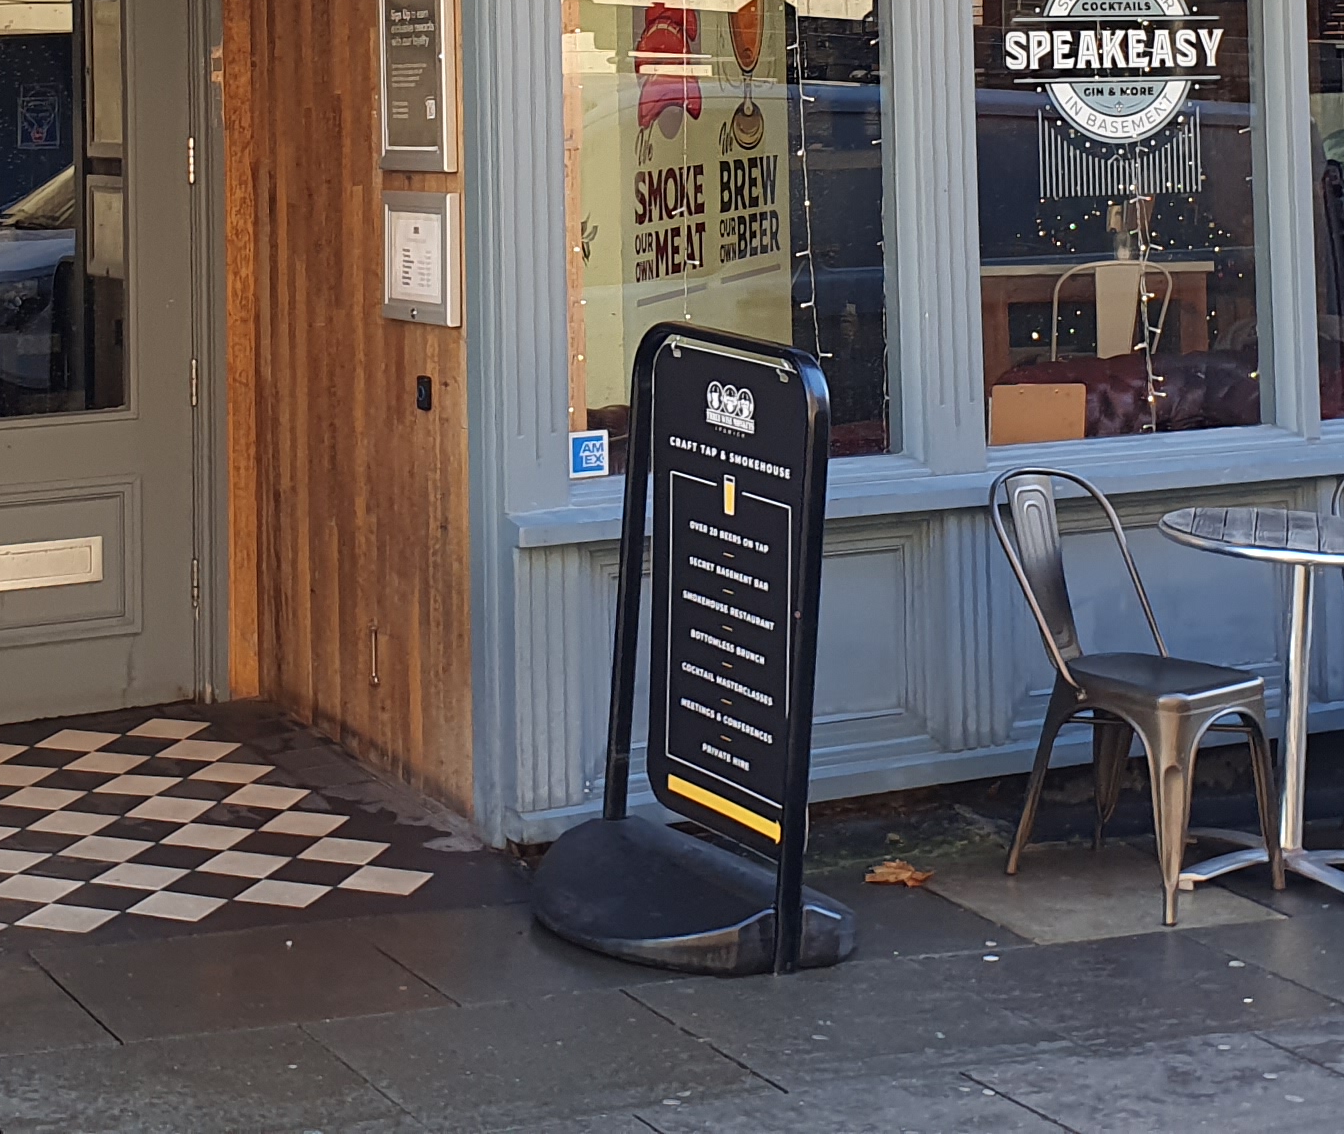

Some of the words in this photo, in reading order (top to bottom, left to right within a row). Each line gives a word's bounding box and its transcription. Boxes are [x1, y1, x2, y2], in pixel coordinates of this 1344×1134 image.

[1082, 1, 1151, 12] COCKTAILS
[1005, 28, 1224, 68] SPEAKEASY
[1083, 87, 1105, 96] GIN
[1108, 87, 1116, 96] &
[1120, 86, 1153, 96] MORE
[1065, 95, 1081, 116] IN
[1085, 94, 1174, 132] BASEMENT
[635, 164, 705, 225] SMOKE
[719, 155, 777, 212] BREW
[635, 232, 653, 254] OUR
[719, 217, 735, 236] OUR
[737, 210, 779, 259] BEER
[655, 222, 705, 277] MEAT
[720, 242, 735, 263] OWN
[635, 259, 653, 282] OWN
[582, 441, 603, 453] AM
[669, 436, 697, 451] CRAFT
[700, 444, 717, 457] TAP
[720, 450, 727, 461] &
[729, 452, 791, 479] SMOKEHOUSE
[689, 520, 707, 533] OVER
[709, 526, 718, 537] 20
[719, 530, 741, 544] BEERS
[742, 538, 753, 549] ON
[755, 541, 768, 553] TAP
[689, 556, 714, 572] SECRET
[716, 563, 752, 585] BASEMENT
[753, 578, 768, 591] BAR
[682, 589, 728, 613] SMOKEHOUSE
[730, 606, 775, 630] RESTAURANT
[690, 628, 734, 652] BOTTOMLESS
[735, 646, 765, 664] BRUNCH
[681, 661, 714, 681] COCKTAIL
[716, 674, 772, 705] MASTERCLASSES
[680, 697, 714, 717] MEETINGS
[722, 715, 772, 743] CONFERENCES
[702, 742, 730, 762] PRIVATE
[732, 755, 749, 770] HIRE
